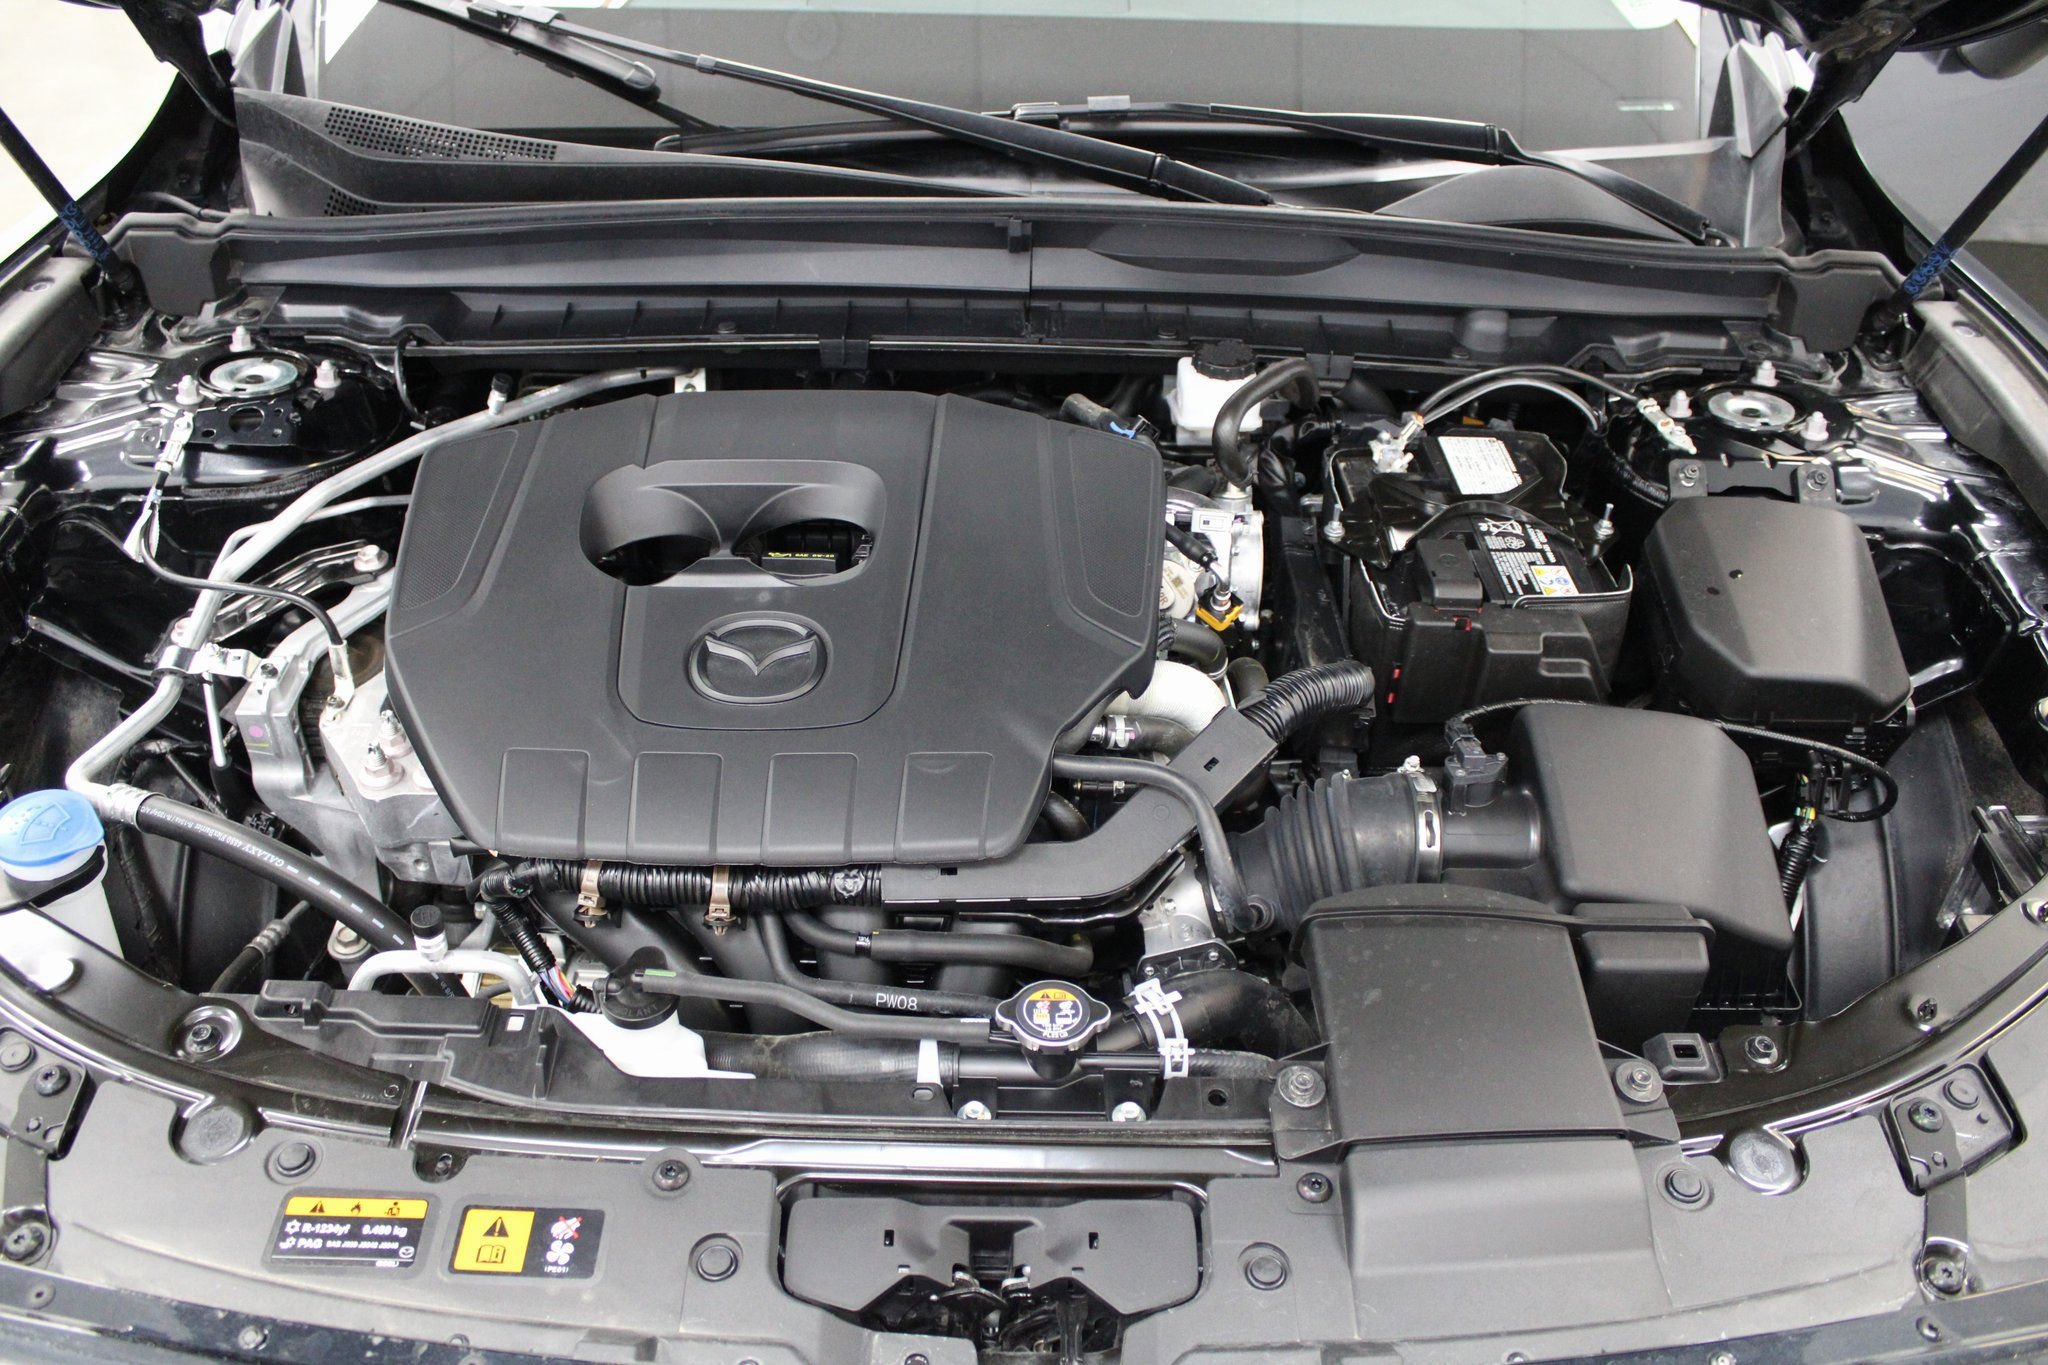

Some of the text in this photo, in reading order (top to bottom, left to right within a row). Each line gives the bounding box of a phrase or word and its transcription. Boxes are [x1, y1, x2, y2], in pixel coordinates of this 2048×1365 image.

[241, 844, 285, 867] GALAXY
[875, 992, 918, 1011] PW08
[302, 1222, 350, 1236] R-1234yf
[393, 1225, 408, 1237] kg
[297, 1237, 323, 1249] PAG
